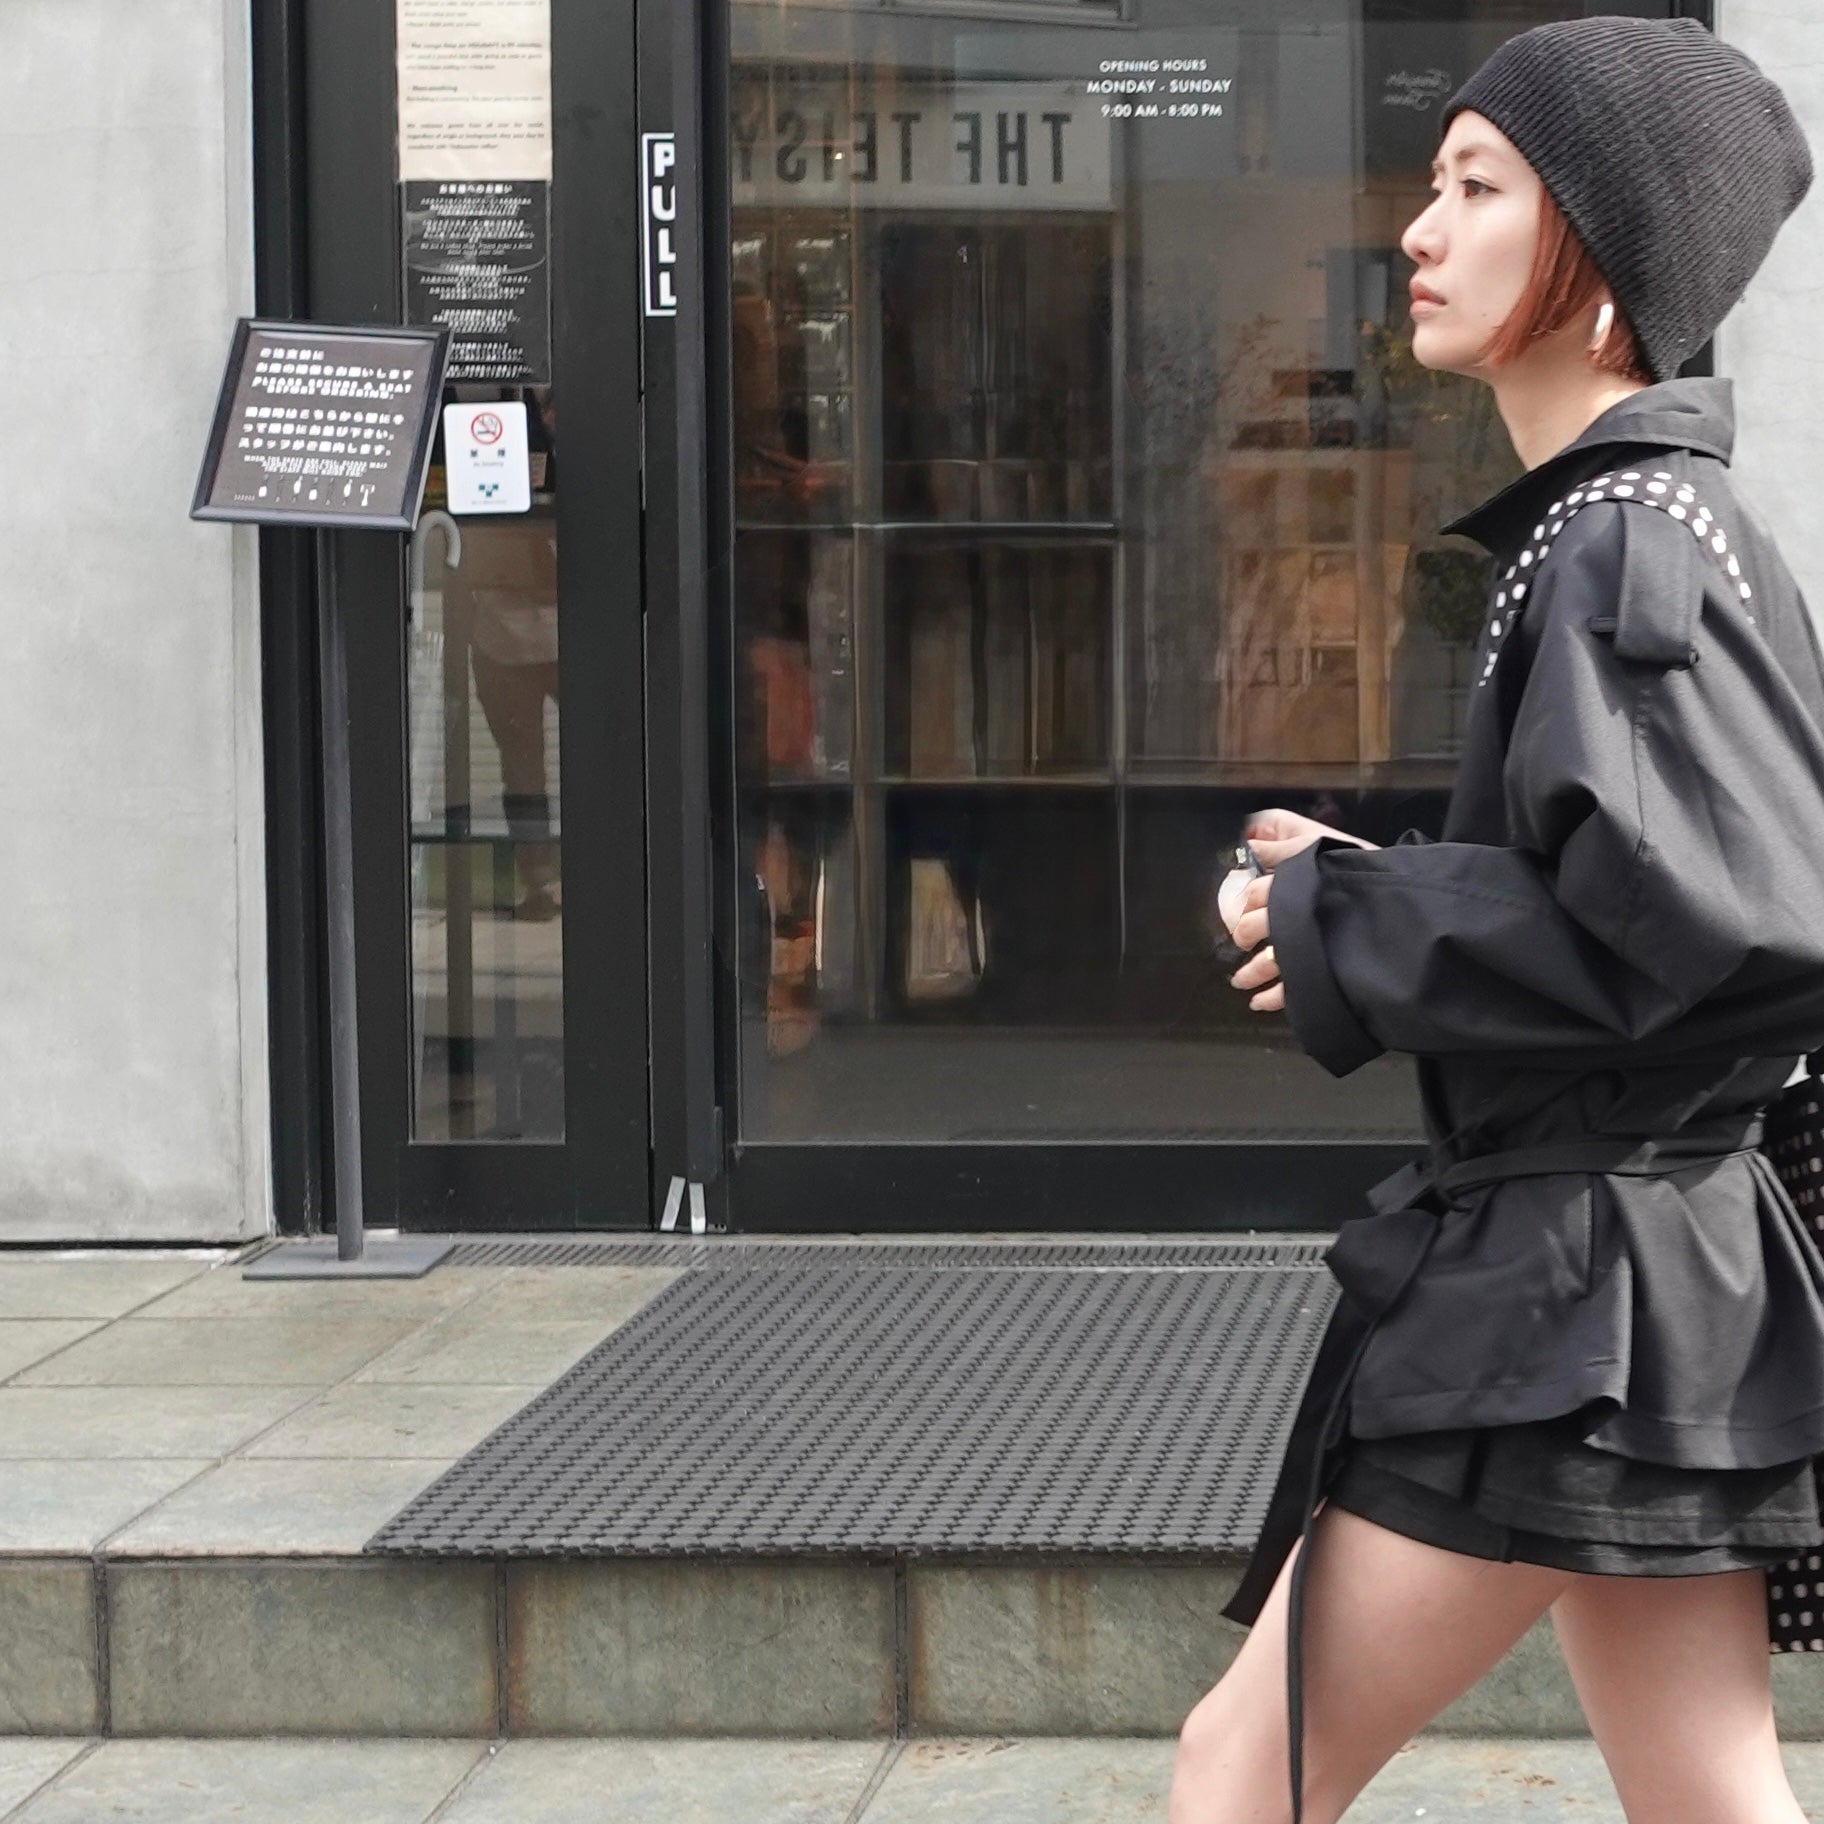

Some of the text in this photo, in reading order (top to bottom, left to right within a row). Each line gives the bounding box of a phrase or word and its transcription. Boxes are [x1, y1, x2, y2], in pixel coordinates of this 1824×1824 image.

[1099, 59, 1207, 73] OPENING HOURS
[1086, 79, 1156, 94] MONDAY
[1169, 79, 1232, 94] SUNDAY
[1101, 104, 1132, 117] 9:00
[1134, 104, 1159, 117] AM
[1201, 104, 1223, 117] PM
[652, 142, 677, 307] PULL
